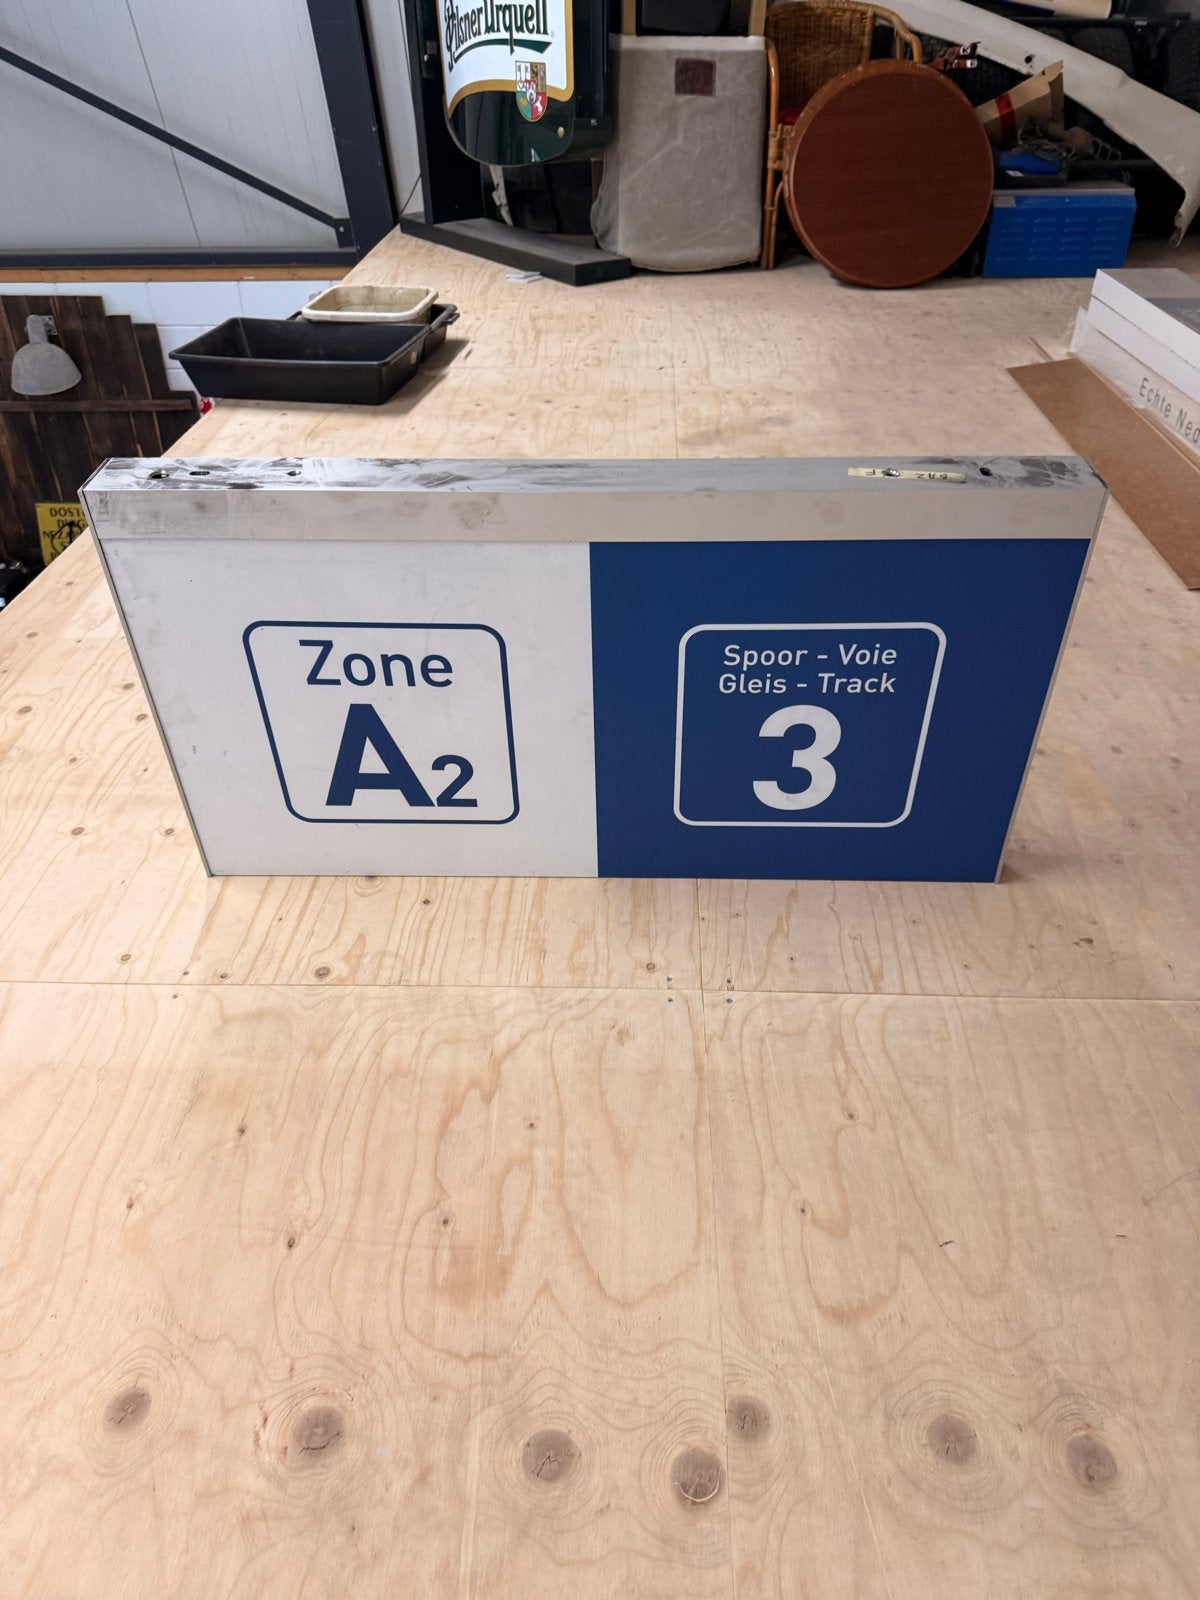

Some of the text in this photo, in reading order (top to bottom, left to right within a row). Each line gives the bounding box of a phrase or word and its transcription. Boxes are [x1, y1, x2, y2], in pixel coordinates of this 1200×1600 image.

[444, 0, 549, 73] Pilsner Urquell
[299, 639, 453, 688] Zone
[718, 673, 787, 694] Gleis
[818, 672, 897, 694] Track
[723, 644, 808, 671] Spoor
[838, 643, 898, 666] Voie
[325, 703, 478, 807] A2
[752, 704, 842, 811] 3
